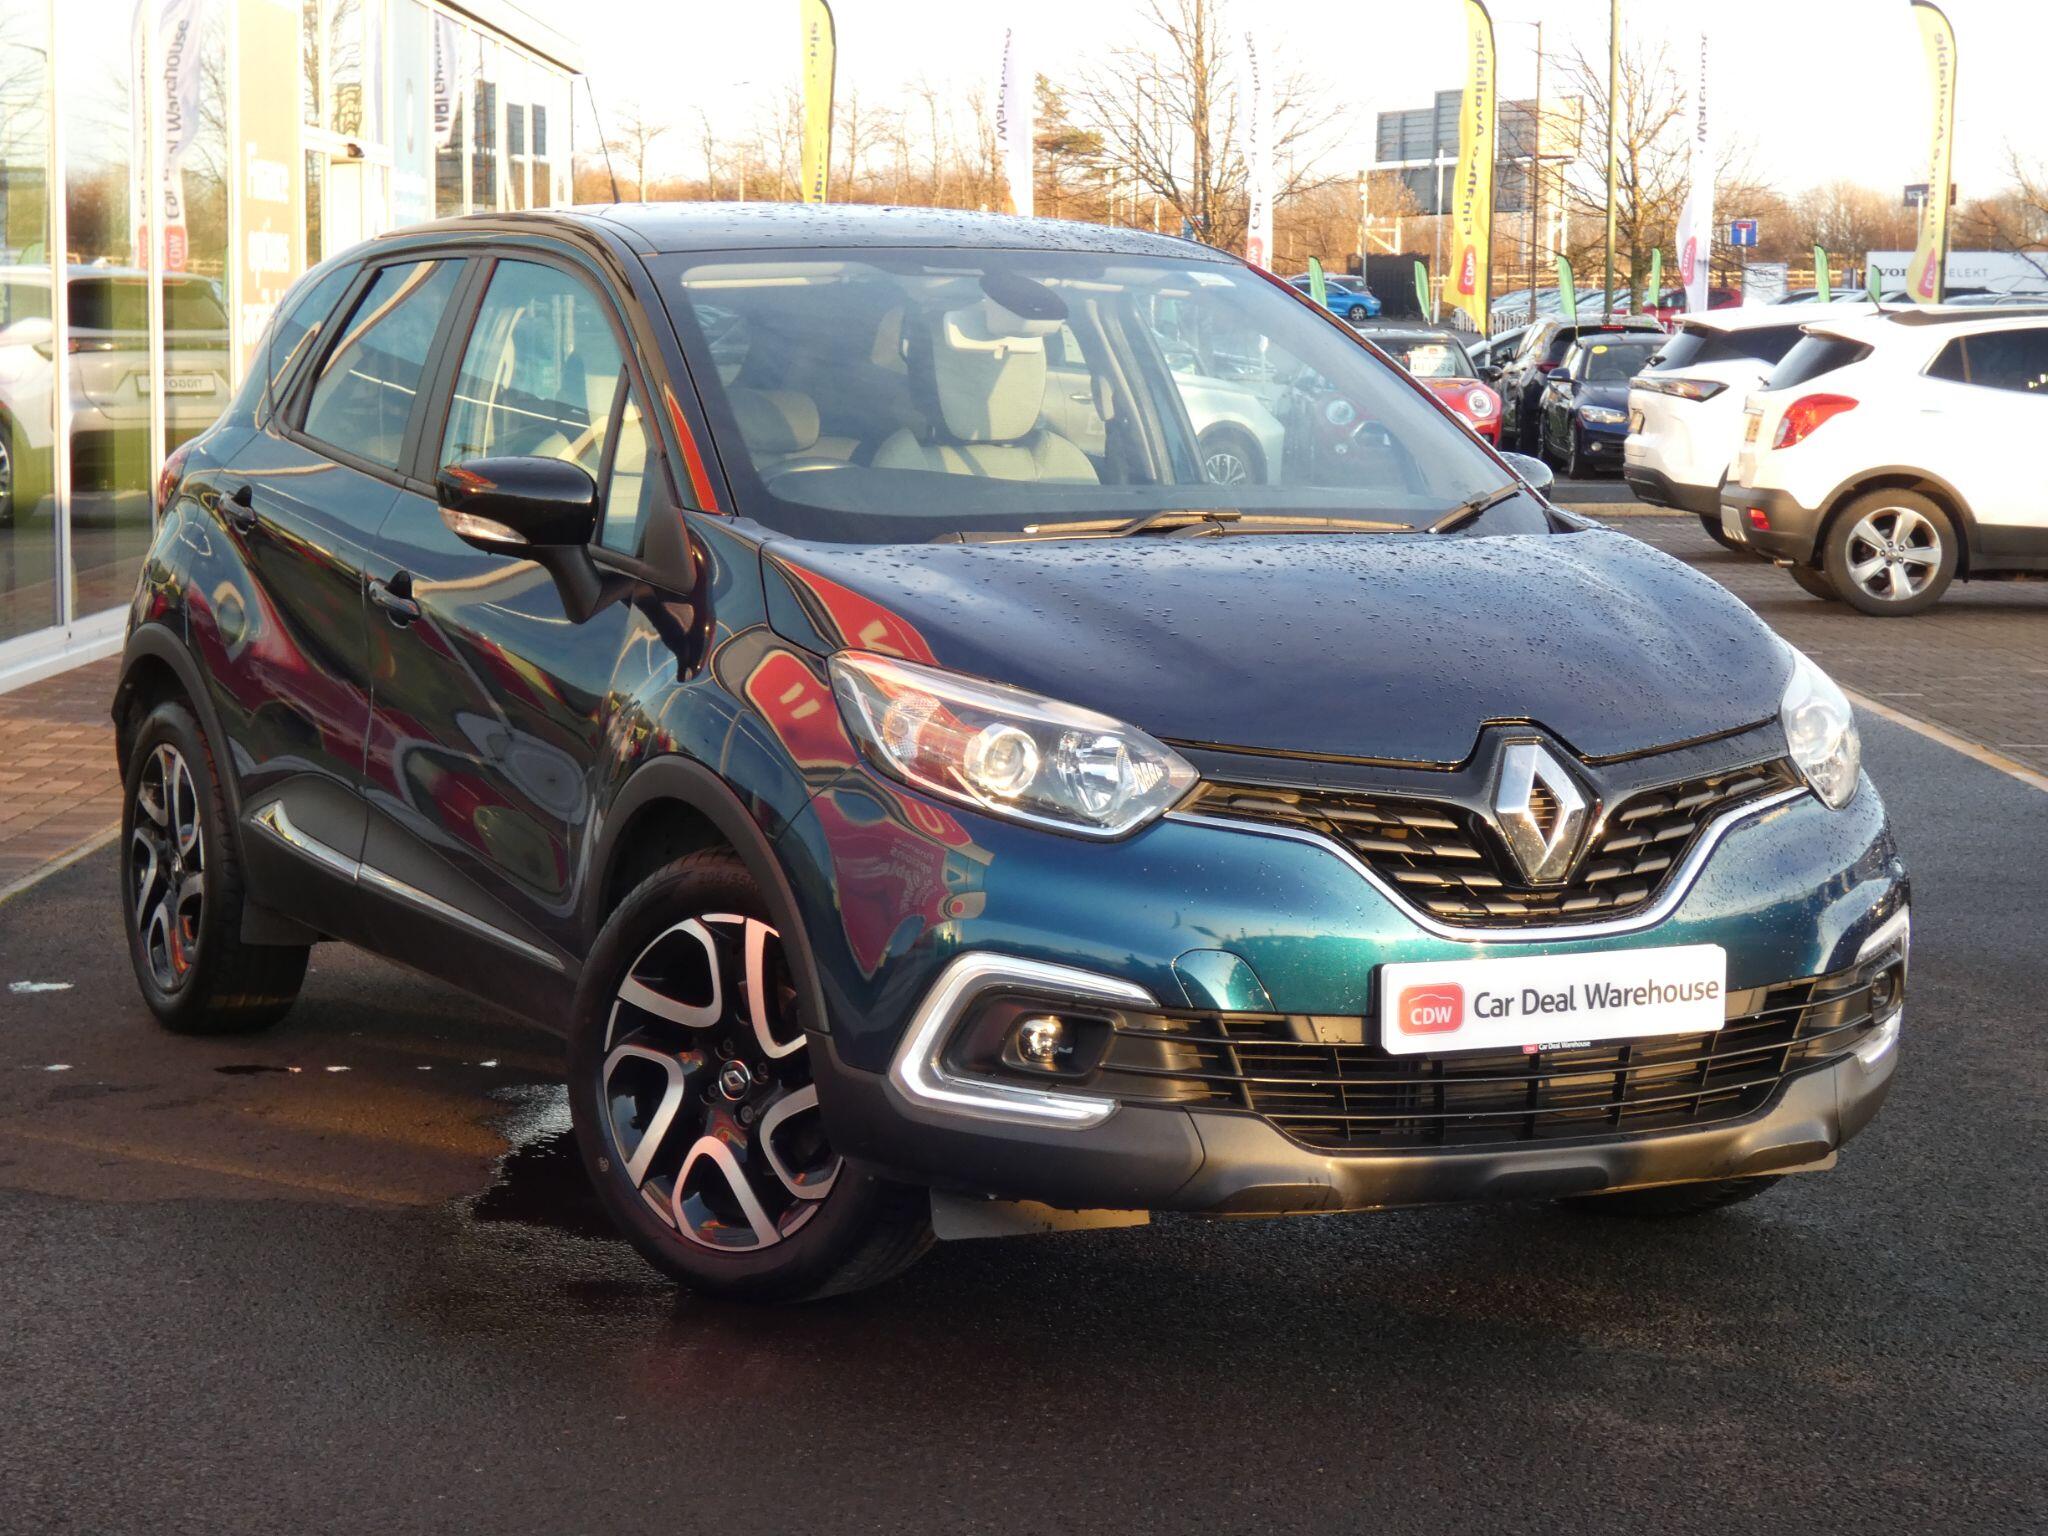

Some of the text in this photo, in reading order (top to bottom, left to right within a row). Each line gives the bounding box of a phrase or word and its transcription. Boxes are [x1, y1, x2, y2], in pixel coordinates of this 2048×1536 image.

[164, 19, 190, 131] Warehouse
[1949, 267, 1989, 278] ELEKT
[1474, 979, 1719, 1019] Car Deal Warehouse
[1411, 1006, 1452, 1025] CDW
